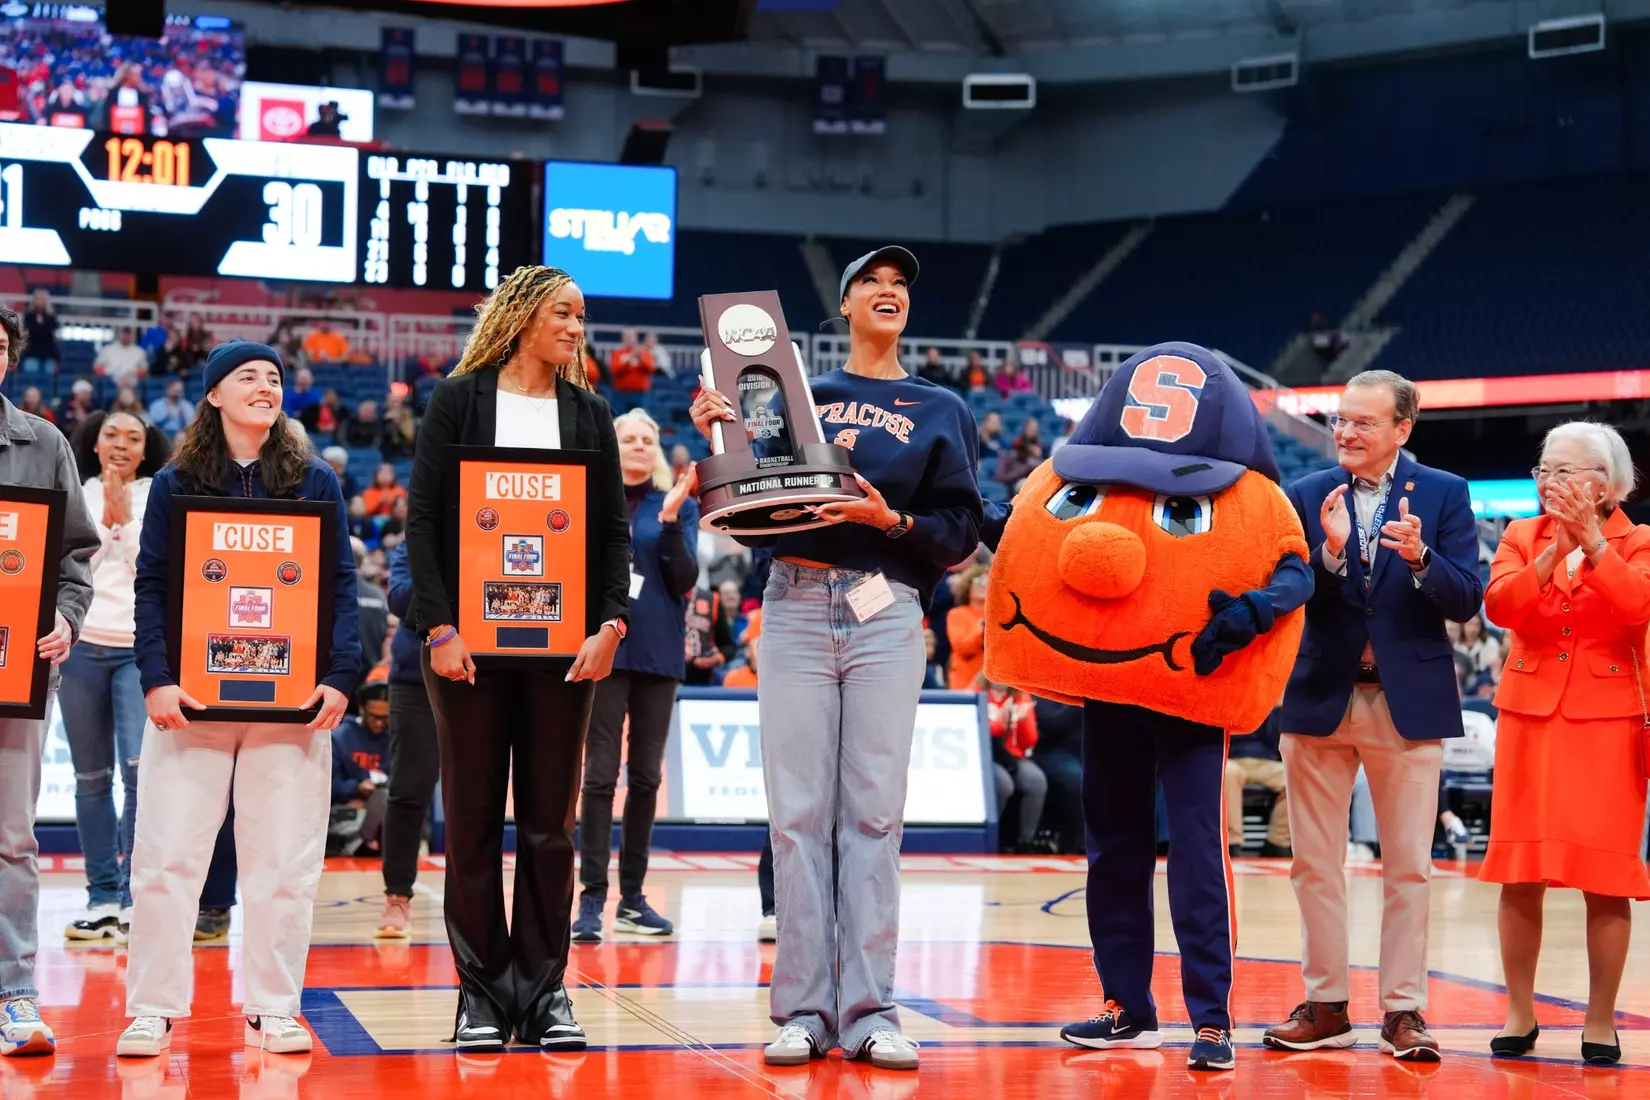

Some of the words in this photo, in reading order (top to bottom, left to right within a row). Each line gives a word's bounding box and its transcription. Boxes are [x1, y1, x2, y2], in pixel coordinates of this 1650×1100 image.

[105, 136, 190, 187] 12:01
[262, 181, 323, 247] 30
[726, 327, 776, 345] NCAA
[738, 381, 771, 391] DIVISION
[1120, 354, 1208, 443] S
[815, 401, 915, 444] YRACUSE
[760, 455, 794, 464] BASKETBALL
[489, 474, 554, 499] 'CUSE
[739, 477, 783, 494] NATIONAL
[217, 526, 285, 551] 'CUSE
